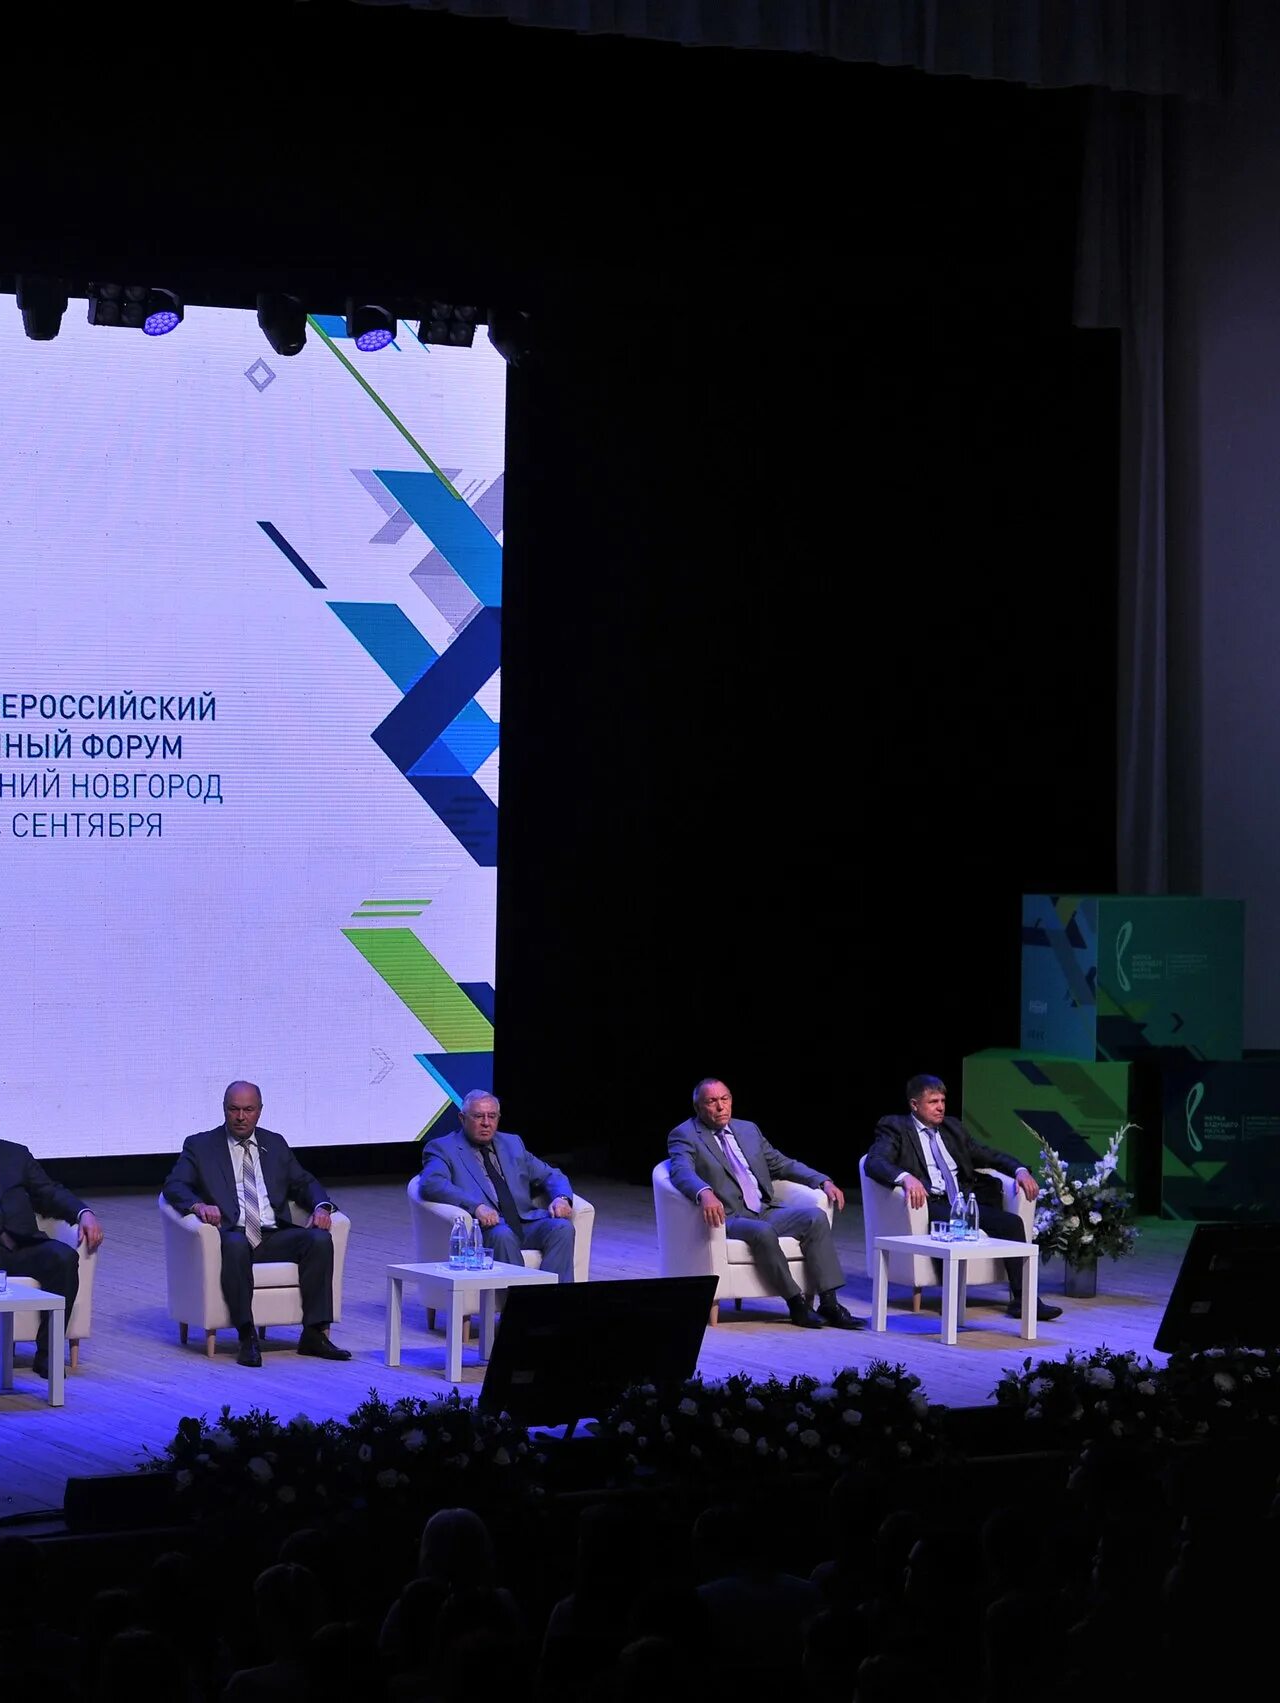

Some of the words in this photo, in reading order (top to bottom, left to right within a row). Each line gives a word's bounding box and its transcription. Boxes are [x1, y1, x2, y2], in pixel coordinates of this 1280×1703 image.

[81, 733, 182, 760] ФОРУМ
[72, 774, 224, 804] НОВГОРОД
[12, 812, 162, 838] СЕНТЯБРЯ
